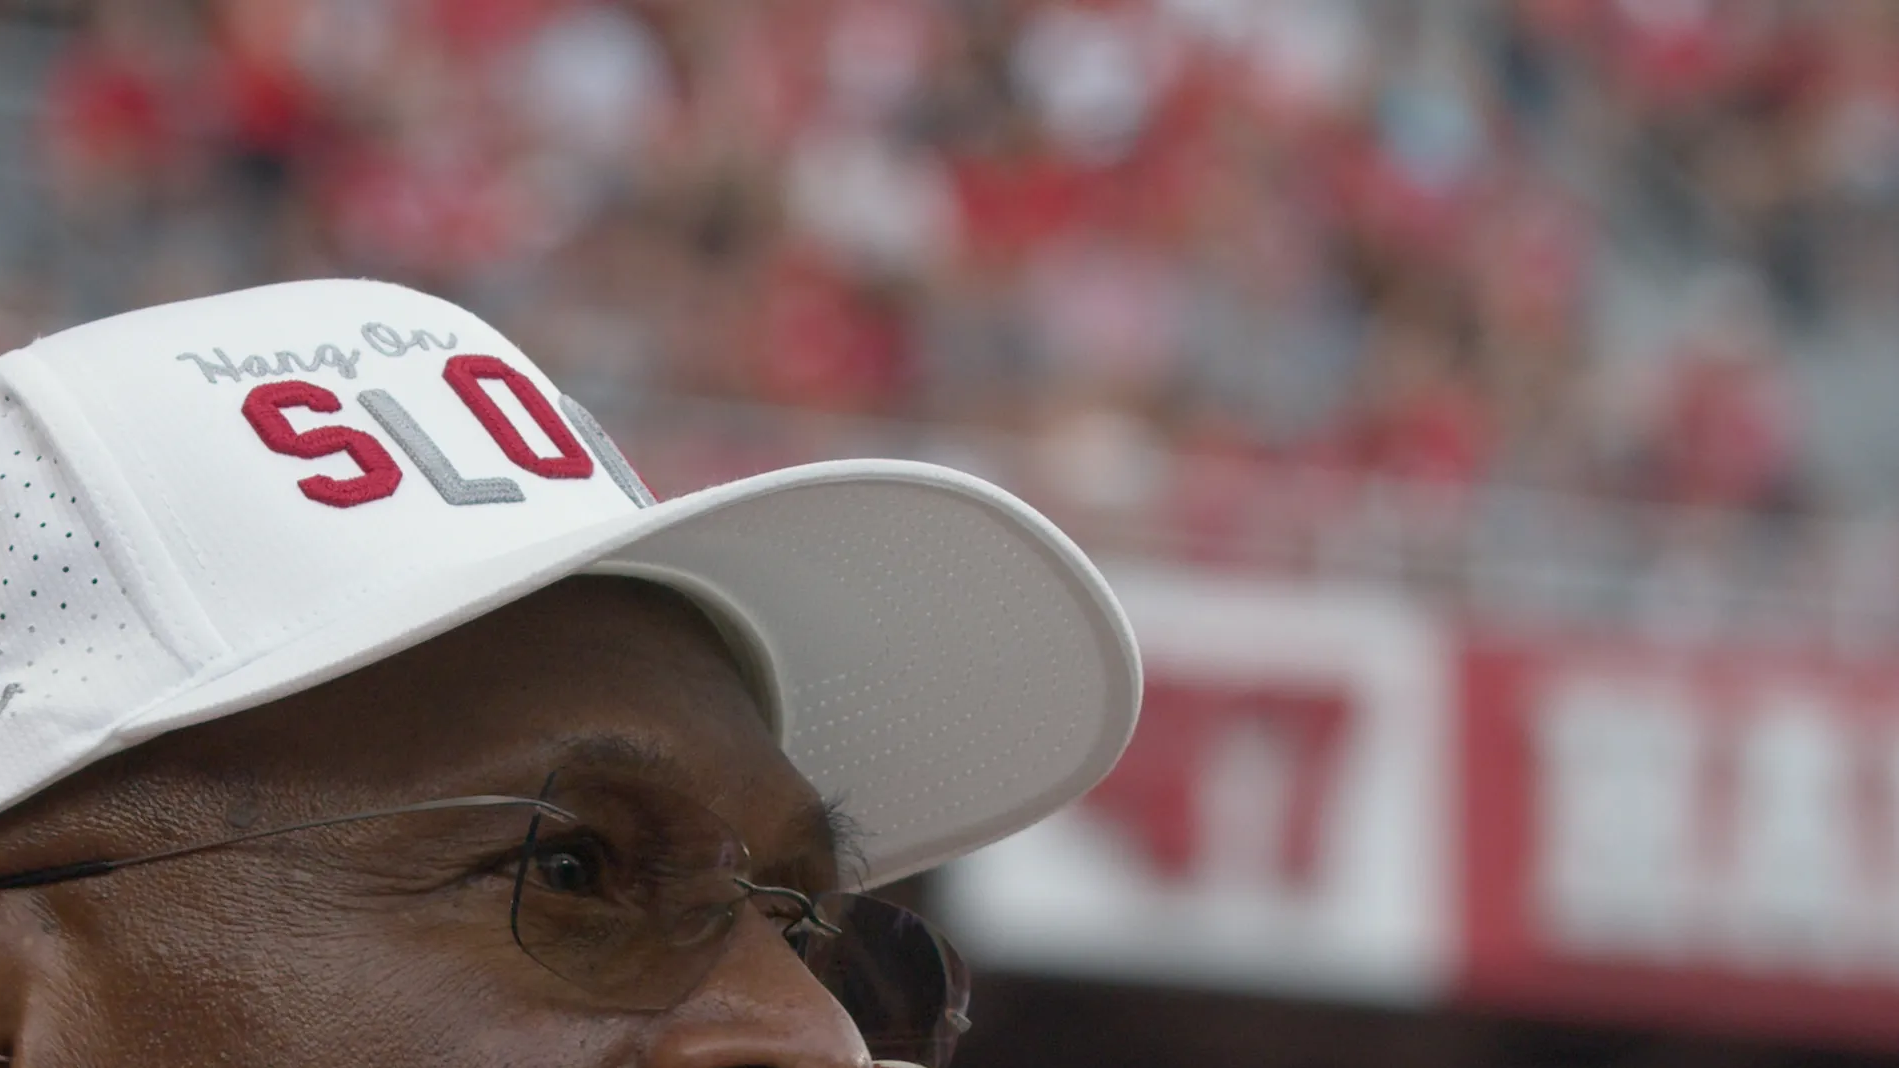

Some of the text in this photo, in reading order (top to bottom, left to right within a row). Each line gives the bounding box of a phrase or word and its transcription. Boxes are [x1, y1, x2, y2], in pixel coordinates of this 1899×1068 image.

[176, 321, 458, 384] Hang On
[241, 354, 659, 509] SLO
